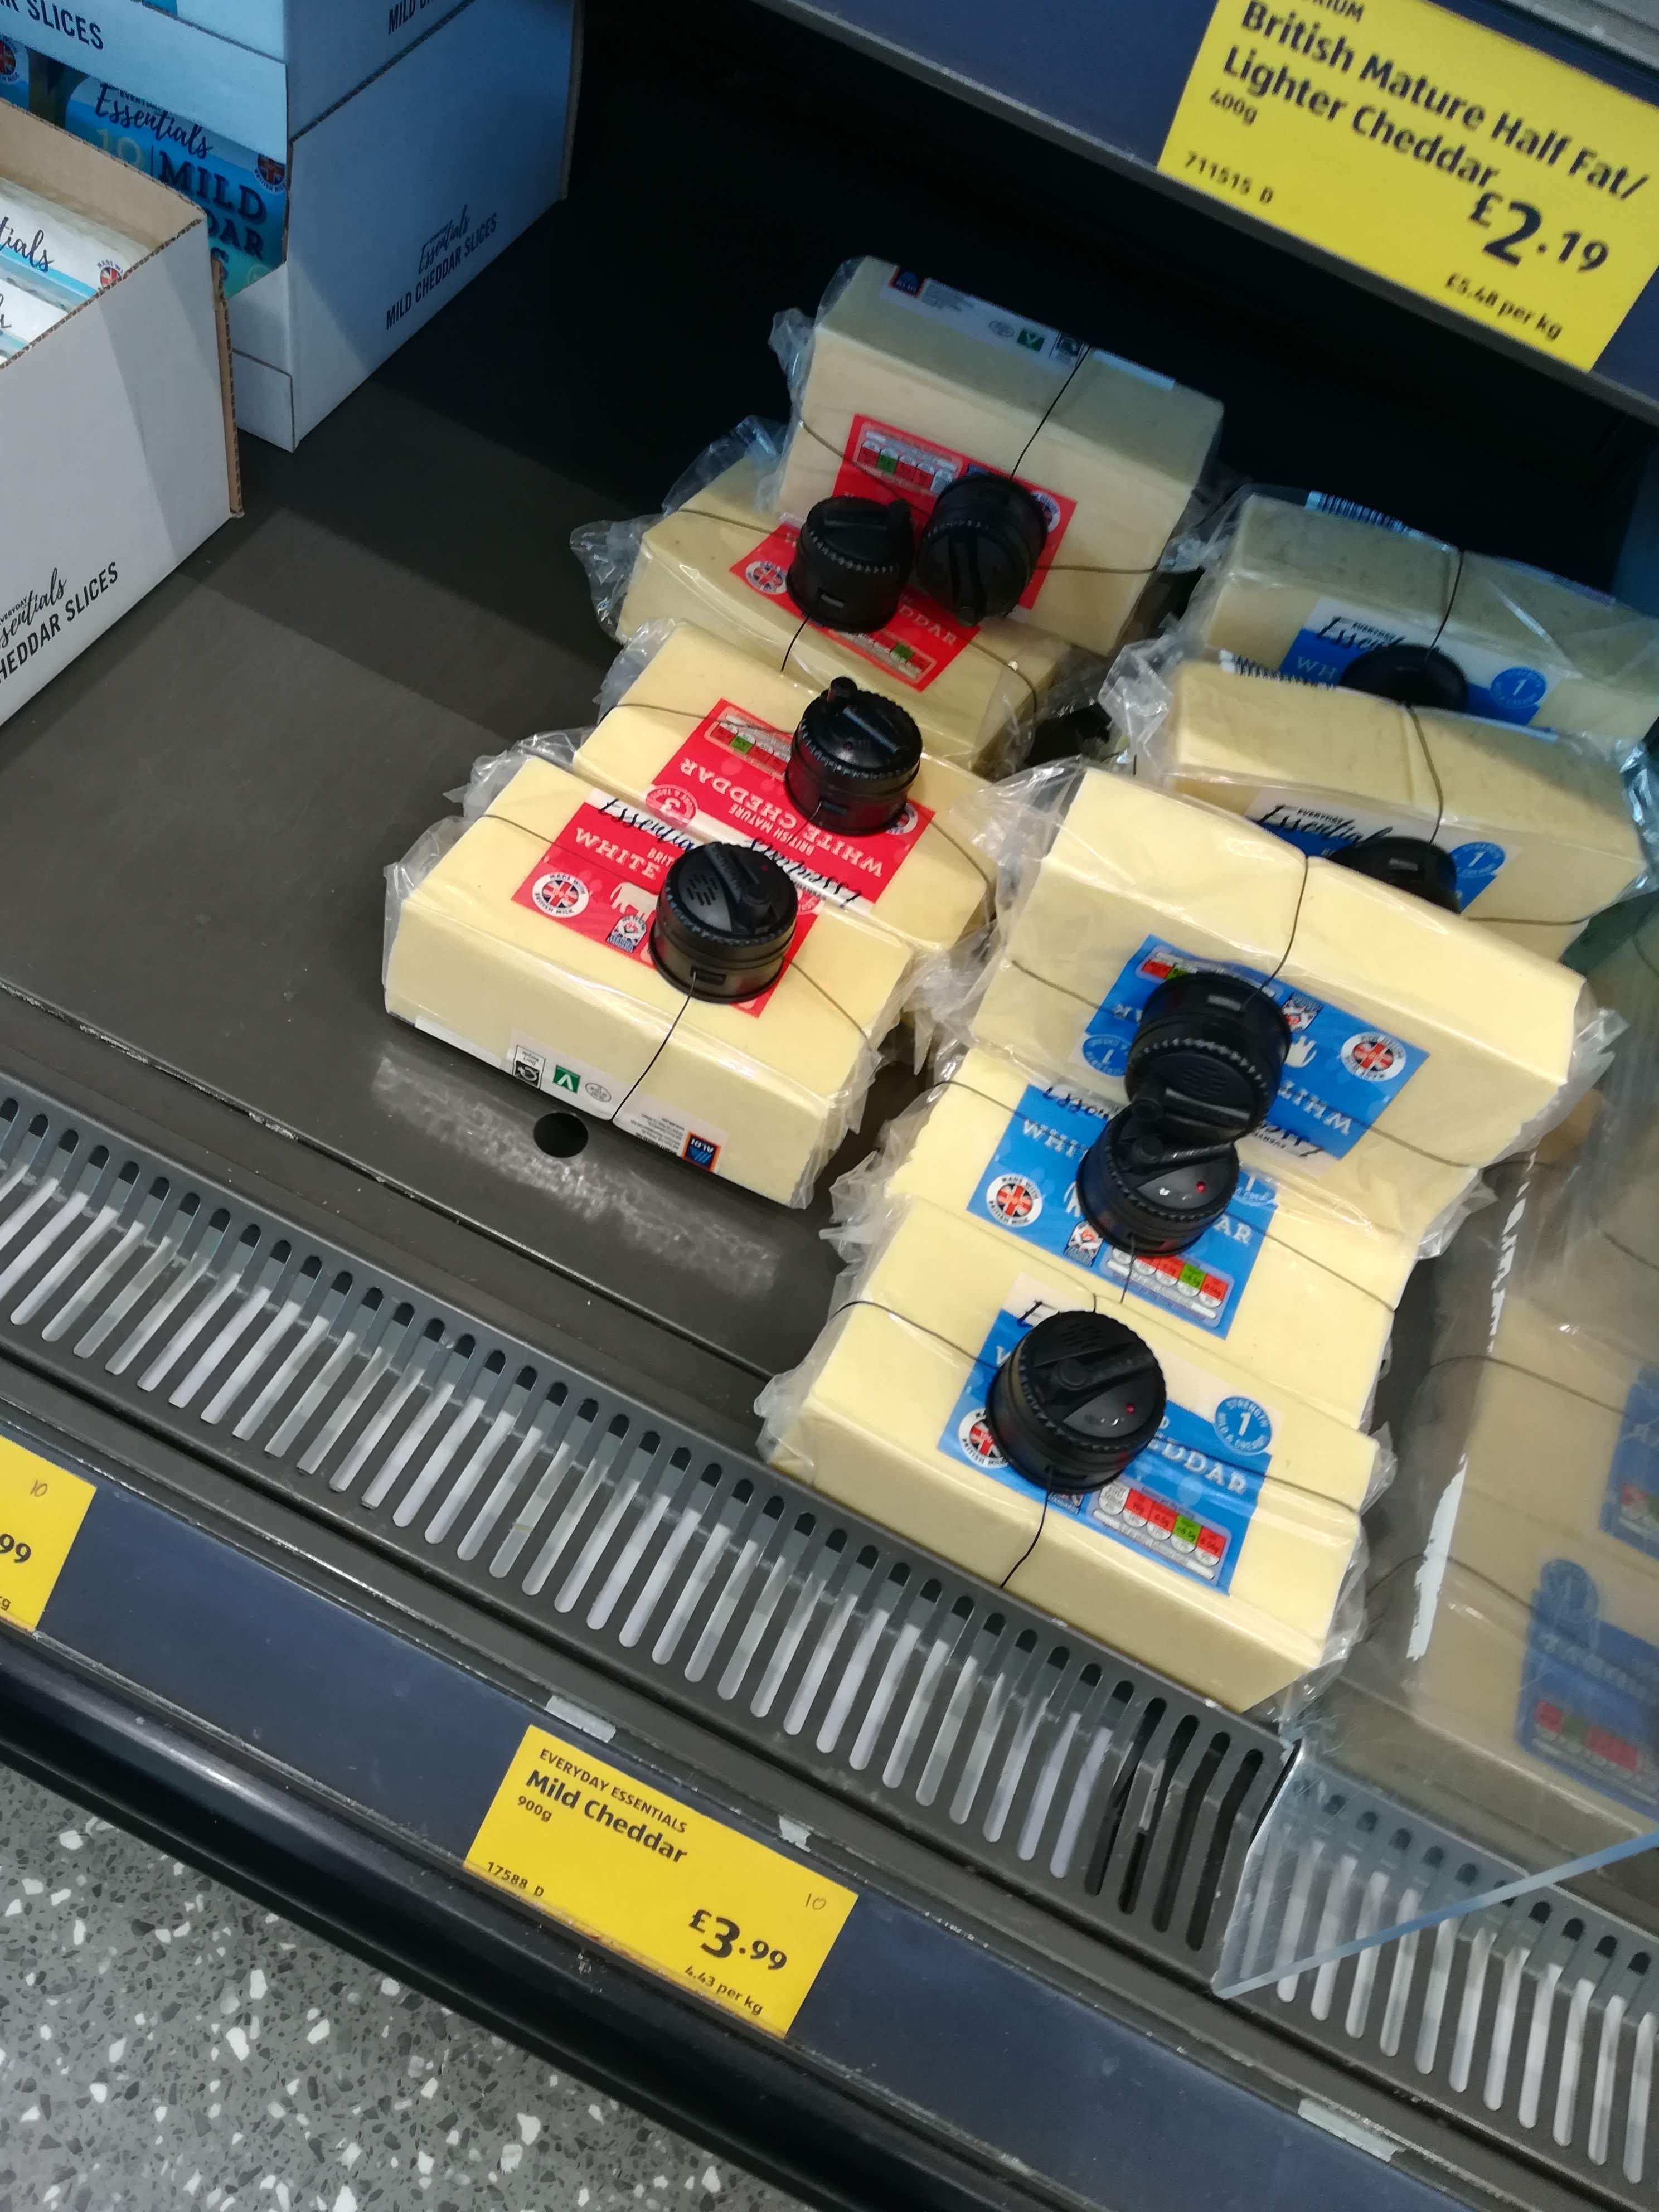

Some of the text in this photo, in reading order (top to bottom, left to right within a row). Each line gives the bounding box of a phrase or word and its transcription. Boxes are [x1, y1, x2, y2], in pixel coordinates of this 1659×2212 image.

[26, 0, 104, 50] SLICES
[94, 83, 213, 159] Essentials
[1210, 88, 1258, 127] 400g
[1223, 45, 1501, 189] Lighter Cheddar
[1241, 0, 1650, 201] British Mature Half Fat/
[159, 150, 265, 224] MILD
[1468, 191, 1609, 273] £2.19
[386, 212, 497, 330] MILD CHEDDAR SLICES
[1498, 300, 1535, 324] per
[1536, 313, 1563, 341] kg
[0, 567, 67, 648] sentials
[0, 596, 27, 625] VERYDAY
[65, 562, 118, 622] SLICES
[680, 758, 883, 877] WHITE CHEDDAR
[729, 803, 775, 834] MATURE
[775, 827, 816, 856] BRITISH
[575, 827, 661, 880] WHITE
[647, 847, 675, 866] BRIT
[1278, 1080, 1354, 1136] WHIT
[691, 1138, 715, 1154] ALDI
[1238, 1412, 1251, 1437] 1
[30, 1480, 48, 1497] 10
[1155, 1439, 1248, 1495] DDAR
[517, 1795, 552, 1822] 900g
[526, 1769, 688, 1863] Mild Cheddar
[540, 1748, 687, 1833] EVERYDAY ESSENTIALS
[487, 1862, 545, 1897] 17588 D
[806, 1893, 826, 1910] 10
[688, 1909, 787, 1970] £3.99
[685, 1966, 763, 2016] 4.43 per kg
